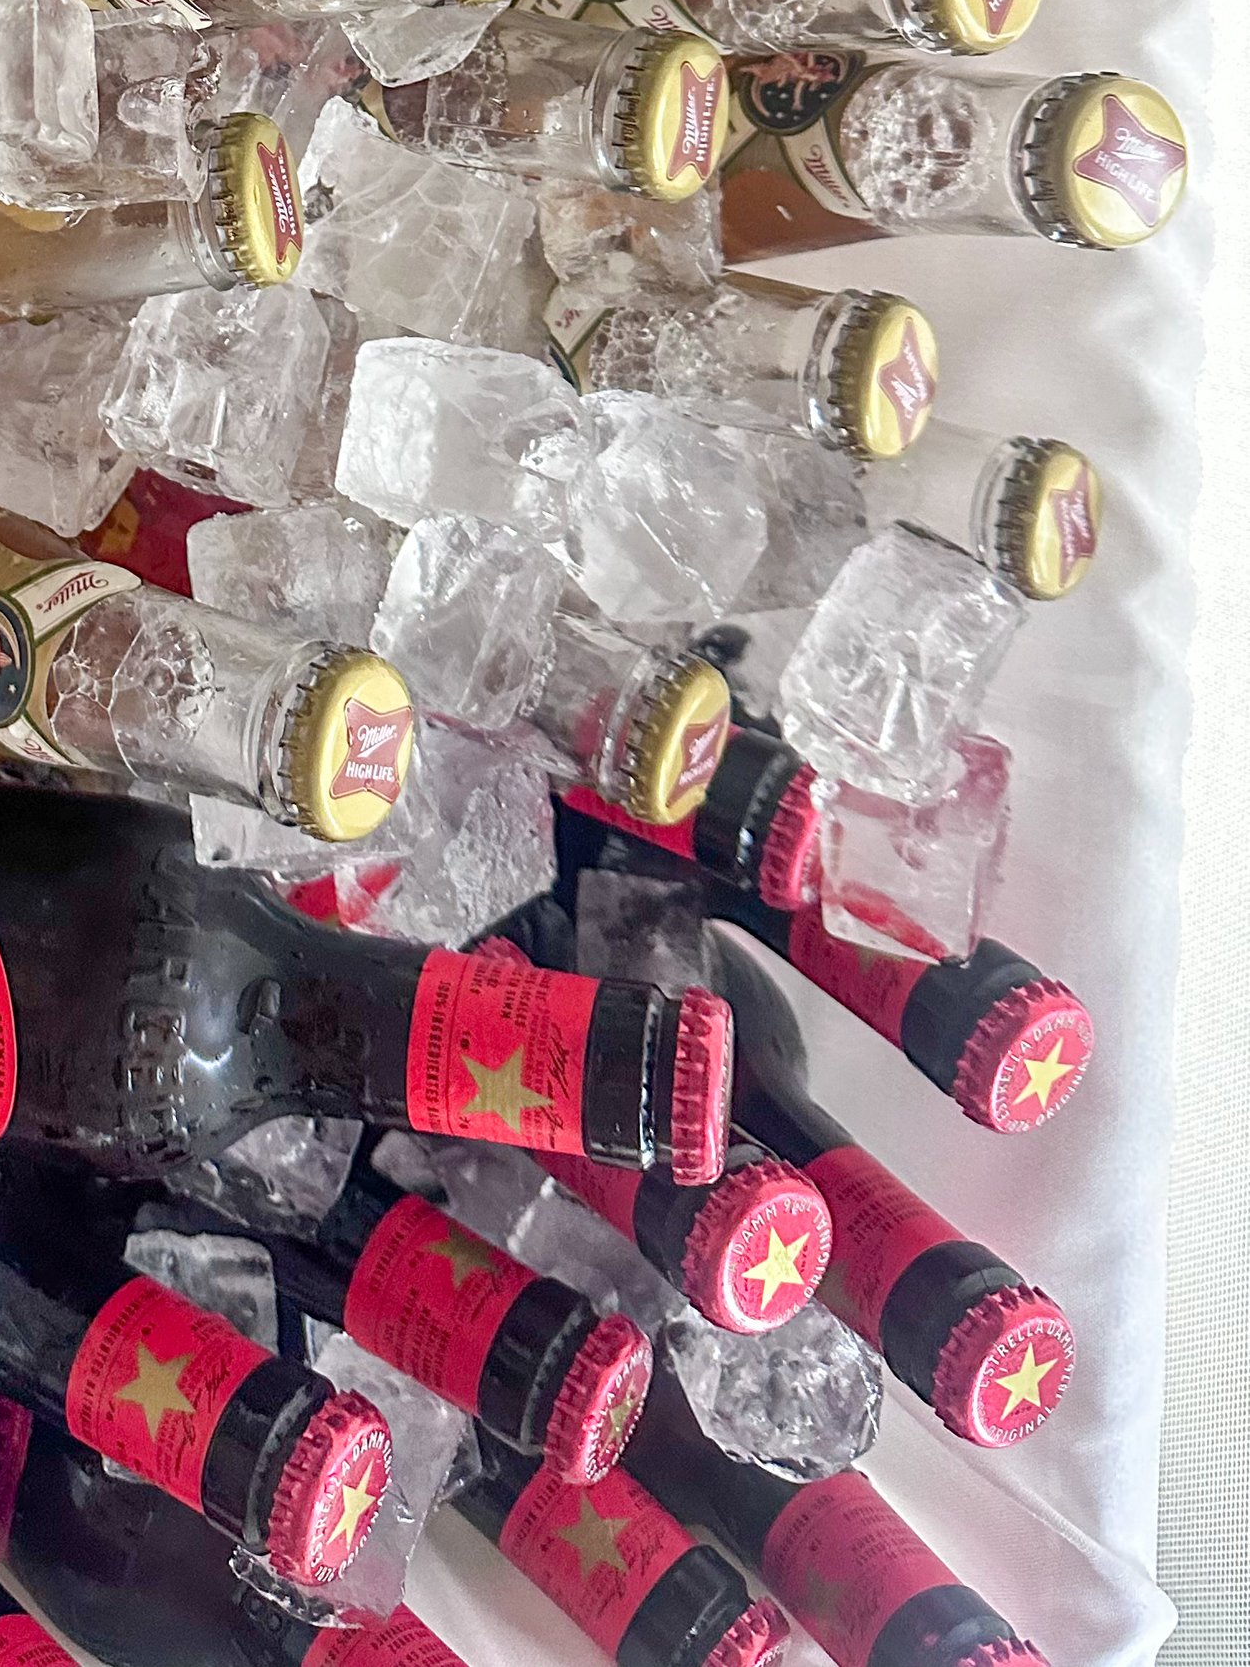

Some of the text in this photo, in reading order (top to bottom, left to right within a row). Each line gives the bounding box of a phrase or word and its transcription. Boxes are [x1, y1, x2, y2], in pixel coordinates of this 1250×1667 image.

[681, 91, 700, 155] Miller
[695, 82, 715, 163] HIGH LIFE
[1114, 127, 1165, 163] Miller
[805, 143, 849, 208] Miller
[1094, 150, 1130, 182] HIGH
[278, 152, 297, 236] HIGH LIFE
[42, 570, 110, 614] Miller
[357, 723, 395, 759] Miller
[344, 761, 395, 783] HIGH LIFE
[995, 1039, 1032, 1123] ESTRELLA
[733, 1203, 777, 1255] DAMM
[804, 1207, 831, 1299] ORIGINAL
[980, 1317, 1076, 1390] ESTRELLA DAMM
[352, 1431, 385, 1462] DAMM
[986, 1404, 1056, 1444] ORIGINAL
[314, 1565, 336, 1582] 1876
